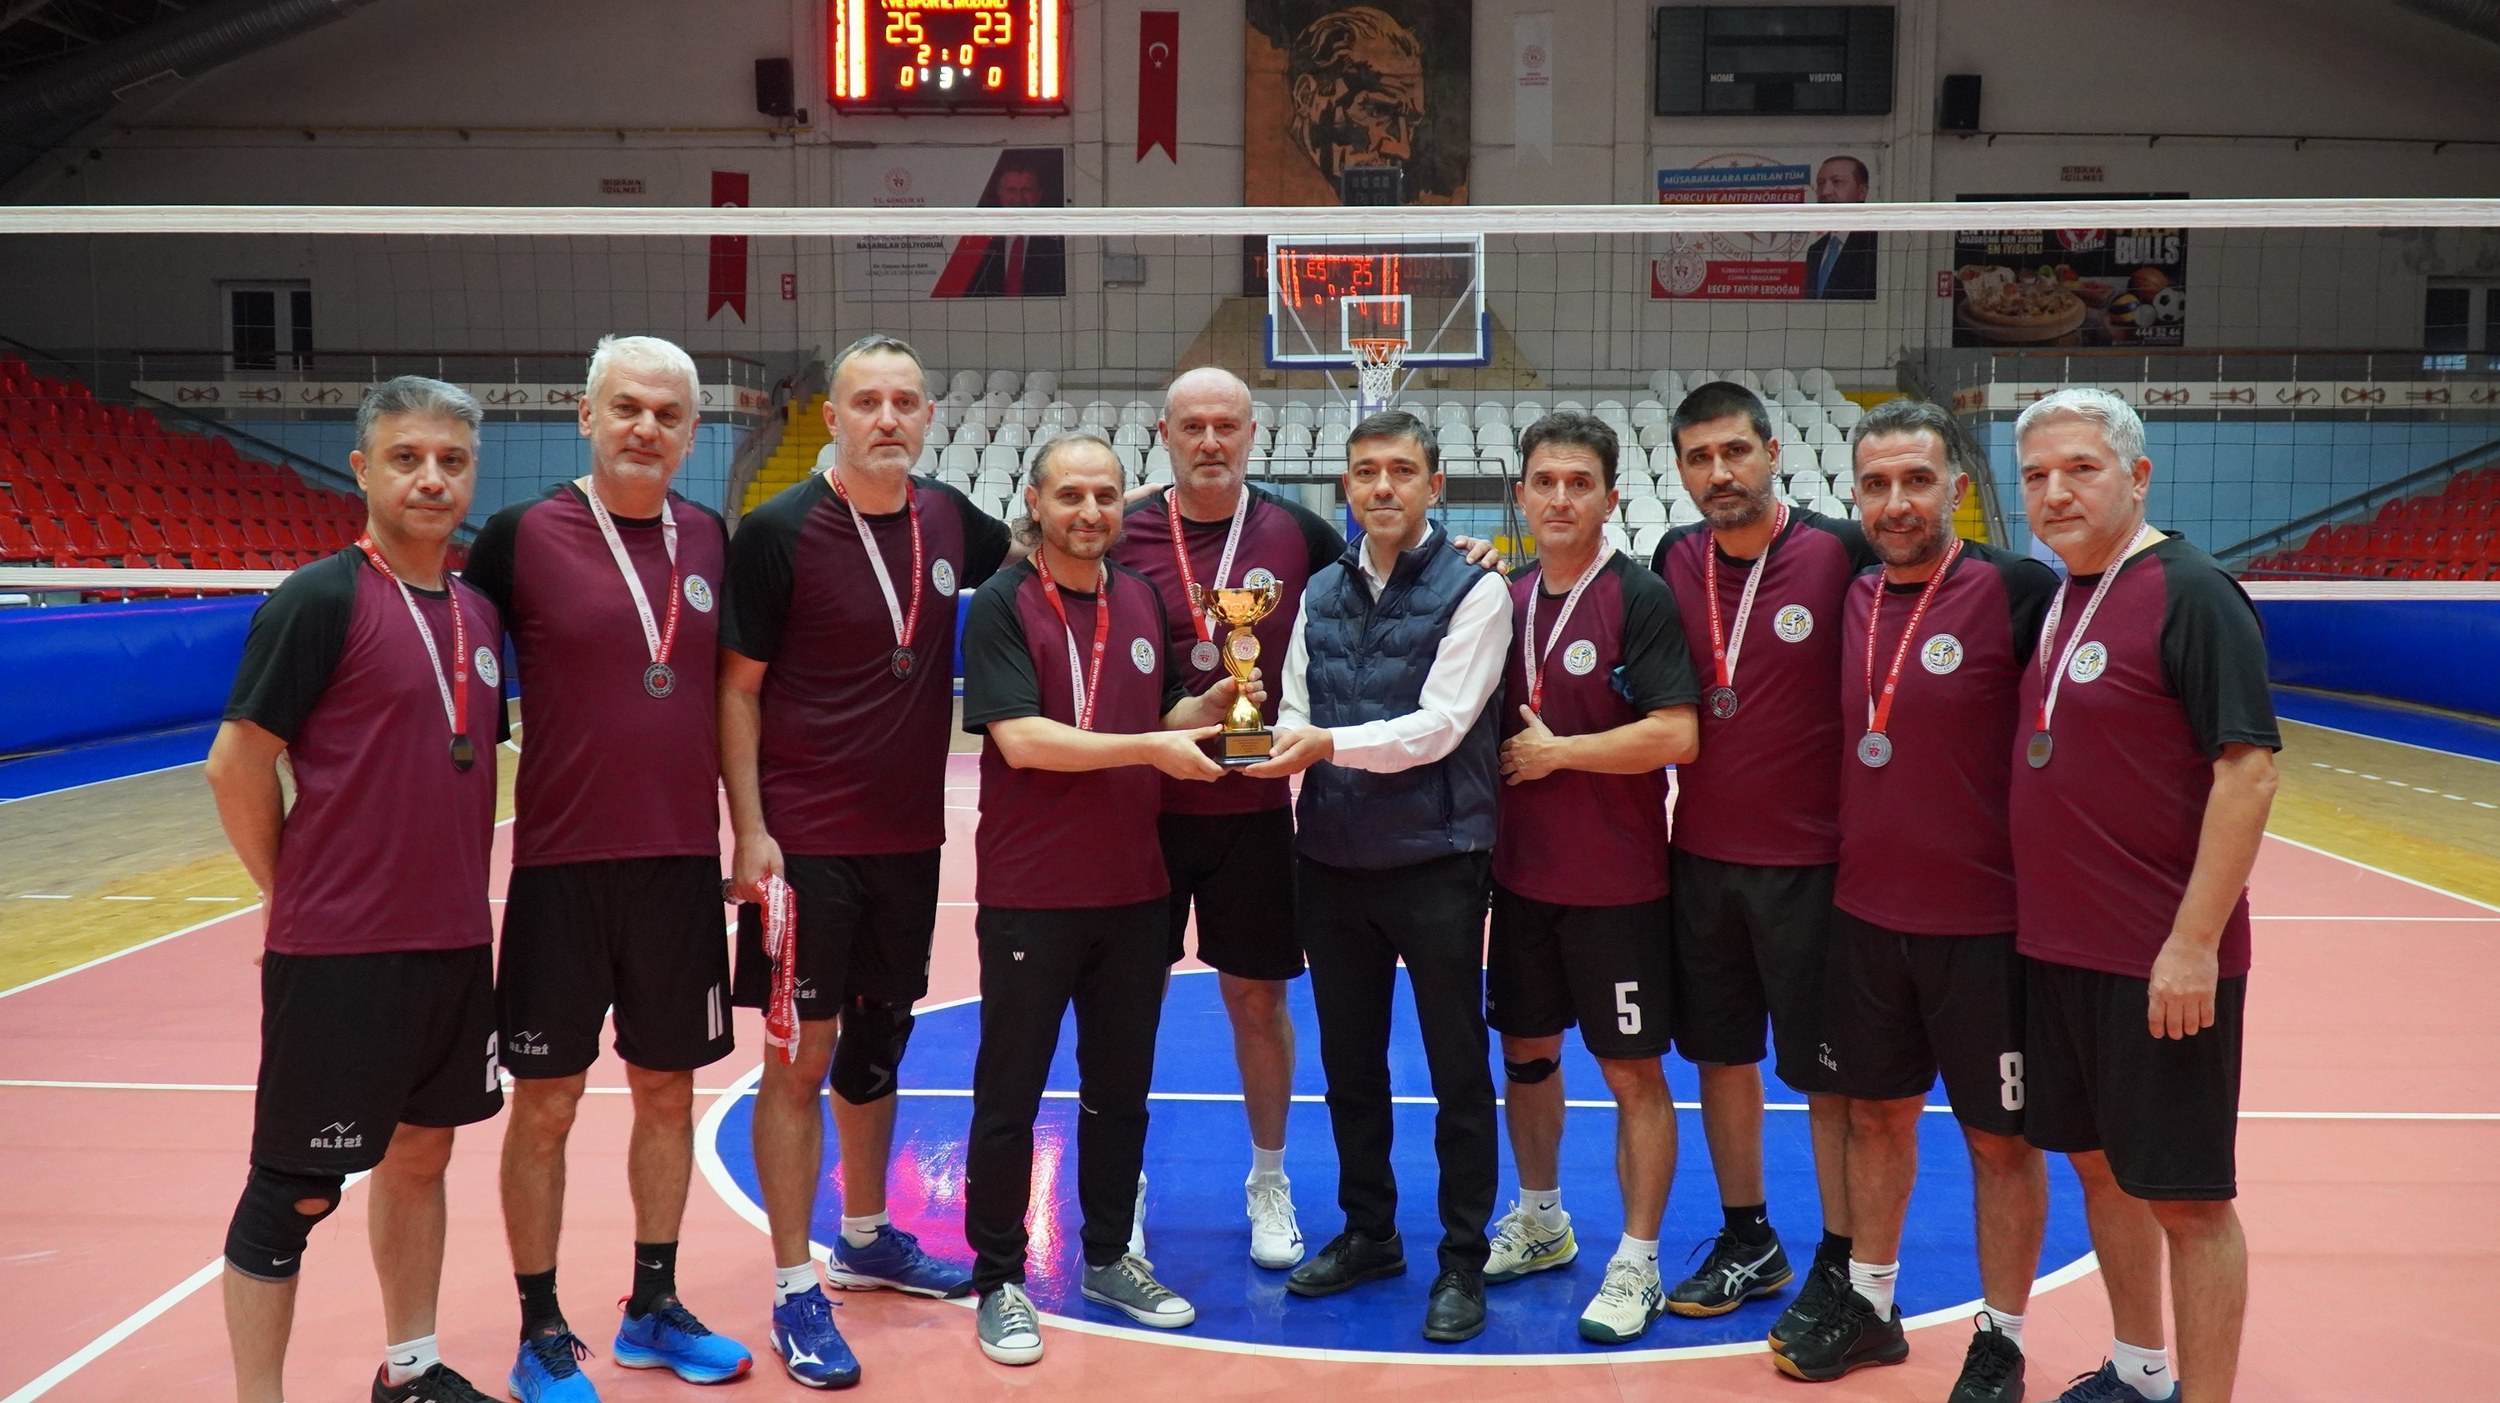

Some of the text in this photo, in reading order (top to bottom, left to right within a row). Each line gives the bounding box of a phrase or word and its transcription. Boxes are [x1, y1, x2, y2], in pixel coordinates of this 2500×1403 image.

[886, 12, 1011, 43] 25 23
[917, 44, 931, 65] 2
[959, 44, 973, 65] 0
[1710, 73, 1843, 83] HOME VISITOR
[1664, 169, 1805, 185] MÜSABAKALARA KATILAN TÜM
[1664, 190, 1801, 203] SPORCU VE ANTRENÖRLERE
[856, 242, 899, 250] BAŞARILAR
[2115, 236, 2181, 265] BULLS
[1707, 284, 1731, 294] RECEP
[1760, 282, 1800, 294] ERDOĞAN
[1711, 619, 1721, 645] TÜRKİYE
[1890, 638, 1909, 677] BAKANLIĞI
[1012, 951, 1025, 961] W
[707, 981, 724, 1041] 11
[1615, 981, 1641, 1035] 5
[2000, 1051, 2024, 1111] 8
